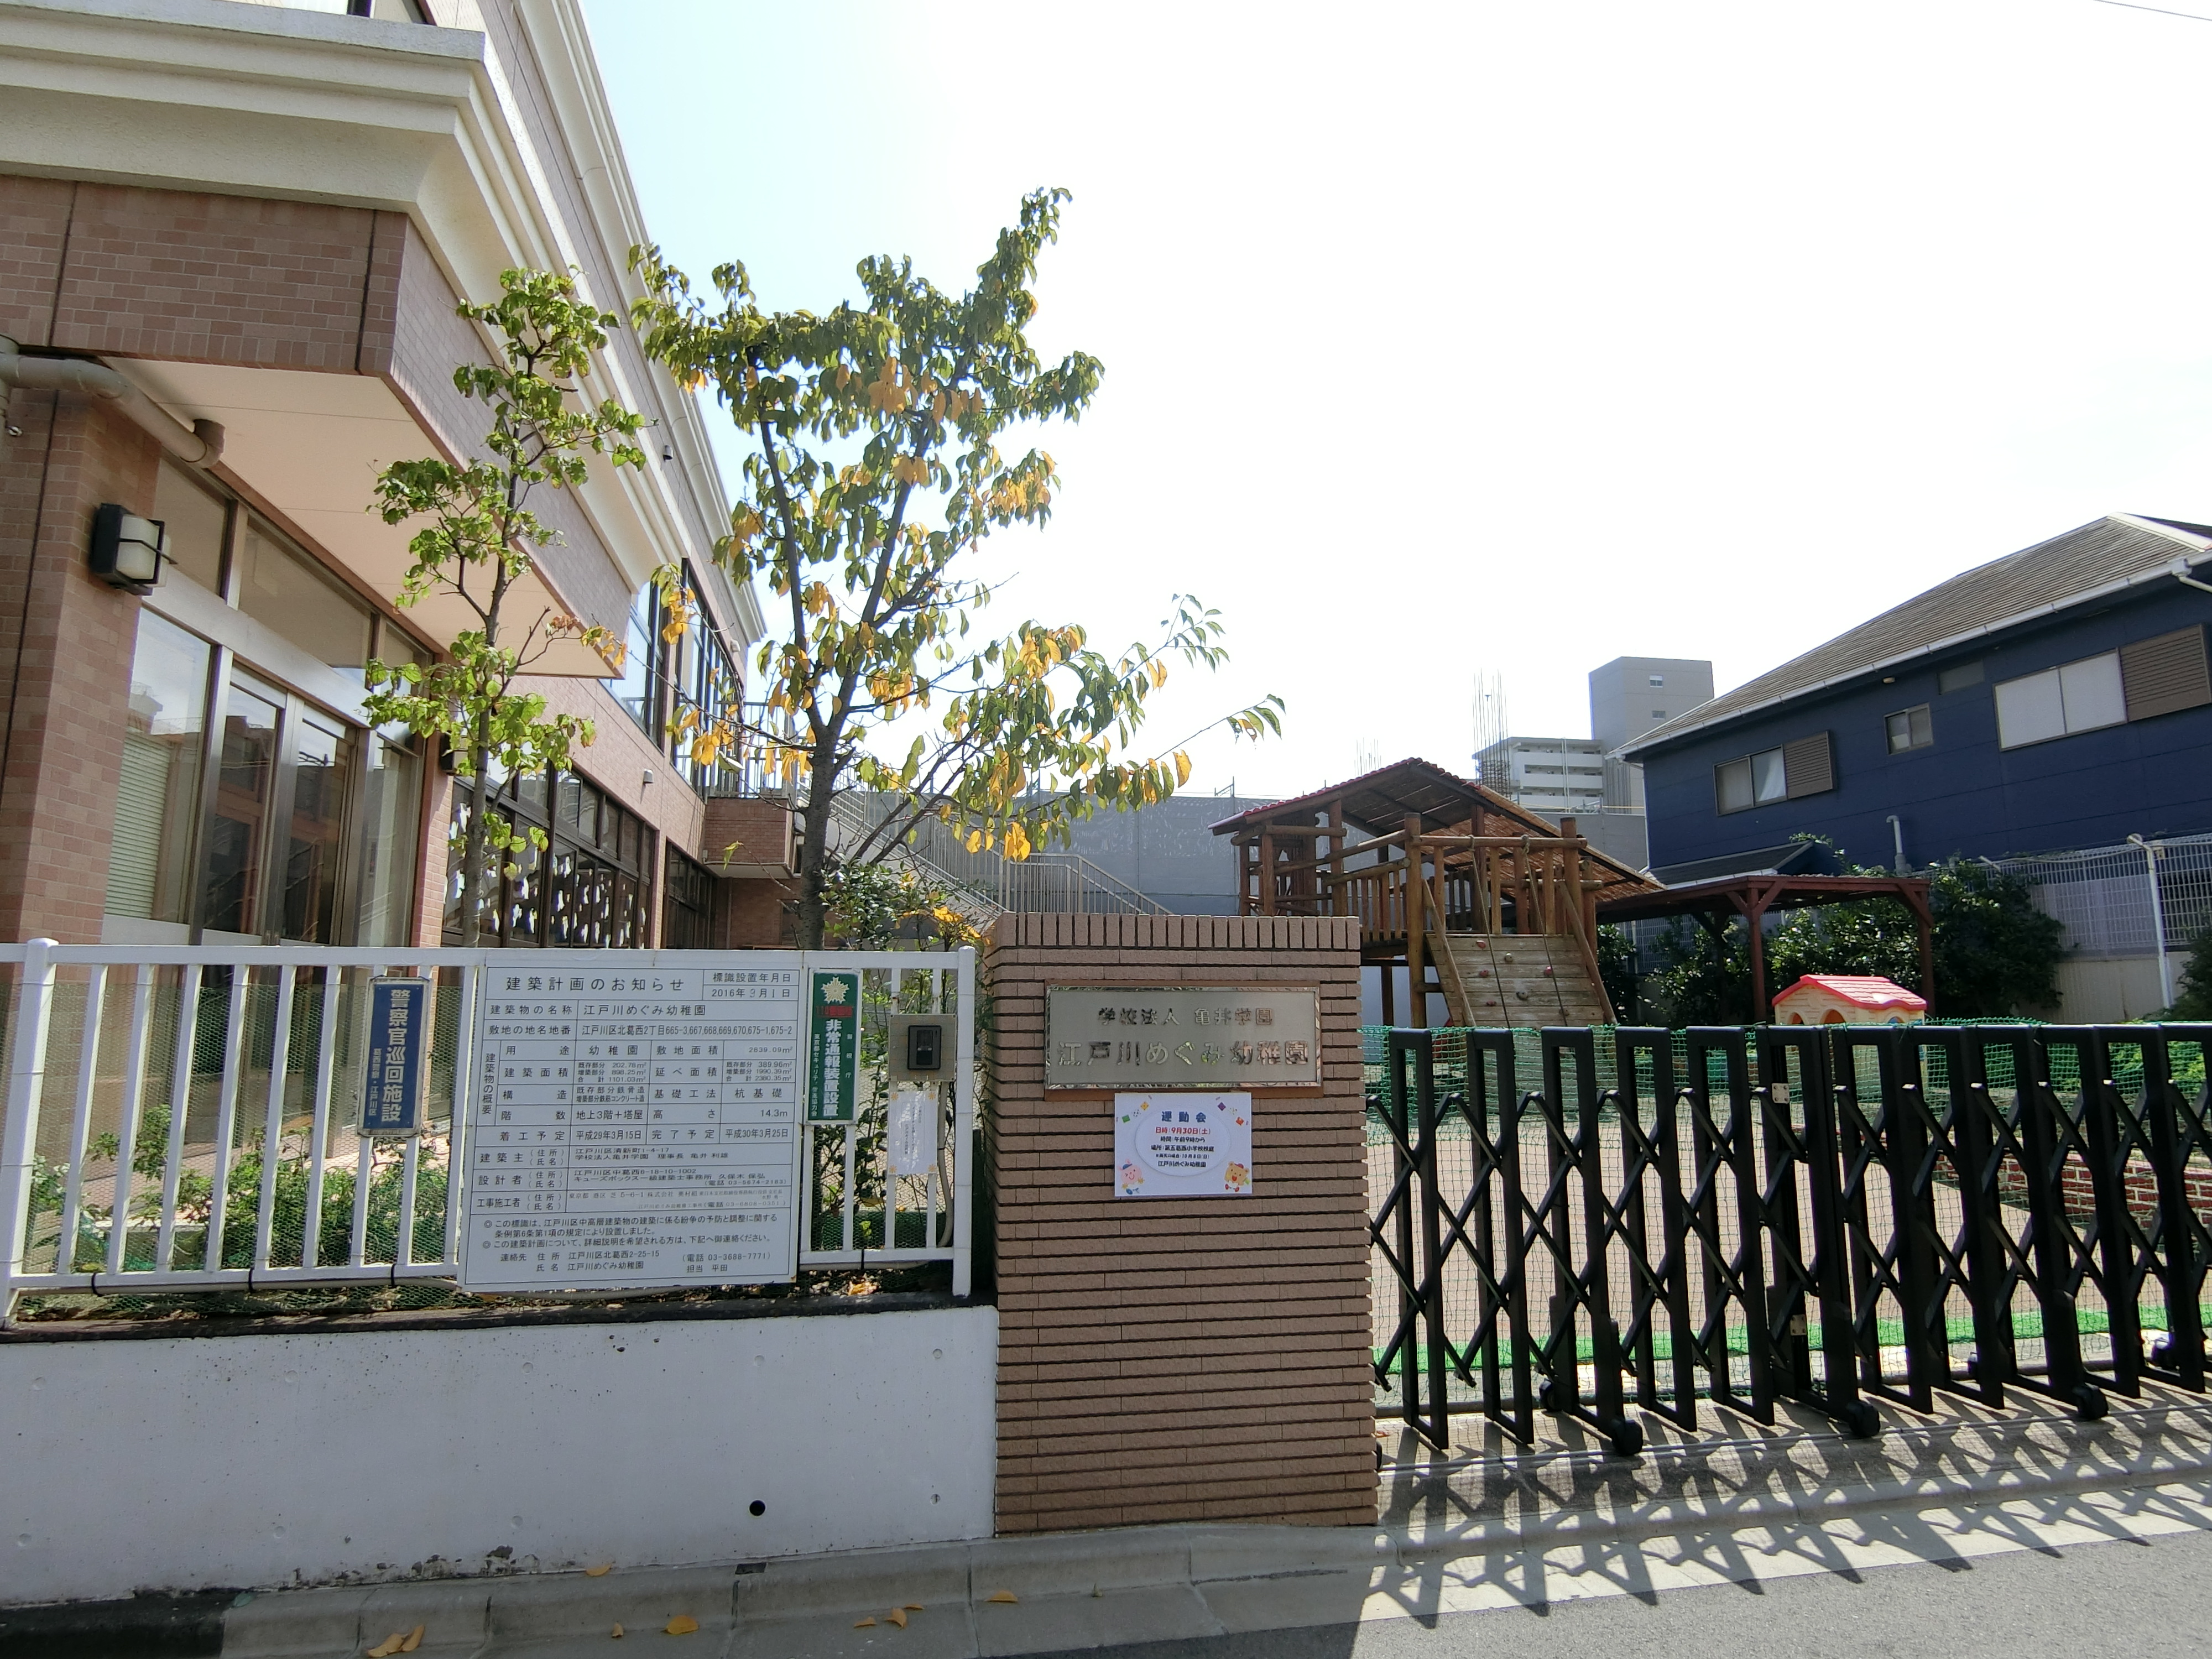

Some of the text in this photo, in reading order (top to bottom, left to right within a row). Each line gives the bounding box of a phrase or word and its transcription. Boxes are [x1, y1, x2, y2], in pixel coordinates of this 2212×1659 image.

[712, 972, 791, 983] 標識設置年月日
[505, 976, 684, 992] 建築計画のお知らせ
[490, 1004, 572, 1015] 建築物の名称
[583, 1004, 706, 1016] 江戸川めぐみ幼稚園
[1099, 1008, 1272, 1026] 学校法人 亀井学園
[489, 1025, 571, 1035] 敷地の地名地番
[382, 989, 411, 1122] 警察官巡回施設
[505, 1045, 570, 1056] 用途
[588, 1045, 638, 1055] 幼稚園
[656, 1045, 718, 1055] 敷地面積
[1058, 1040, 1308, 1065] 江戸川めぐみ幼稚園
[504, 1067, 568, 1078] 建築面積
[655, 1067, 717, 1077] 延べ面積
[823, 1019, 842, 1117] 非常通報装置設置
[482, 1053, 495, 1114] 建築物の概要
[503, 1090, 567, 1100] 構造
[654, 1088, 716, 1099] 基礎工法
[734, 1088, 782, 1098] 杭基礎
[501, 1110, 566, 1120] 階数
[653, 1109, 716, 1119] 高さ
[1161, 1111, 1207, 1123] 運動会
[500, 1131, 565, 1141] 着工予定
[576, 1130, 641, 1140] 平成29年3月15日
[651, 1129, 714, 1139] 完了予定
[725, 1129, 788, 1138] 平成30年3月25日
[480, 1152, 524, 1163] 建築主
[478, 1175, 522, 1185] 設計者
[477, 1197, 521, 1208] 工事施工者
[500, 1250, 660, 1261] 連絡先 住所 江戸川区北葛西2-25-15
[536, 1260, 644, 1272] 氏名 江戸川めぐみ幼稚園
[687, 1265, 703, 1273] 担当
